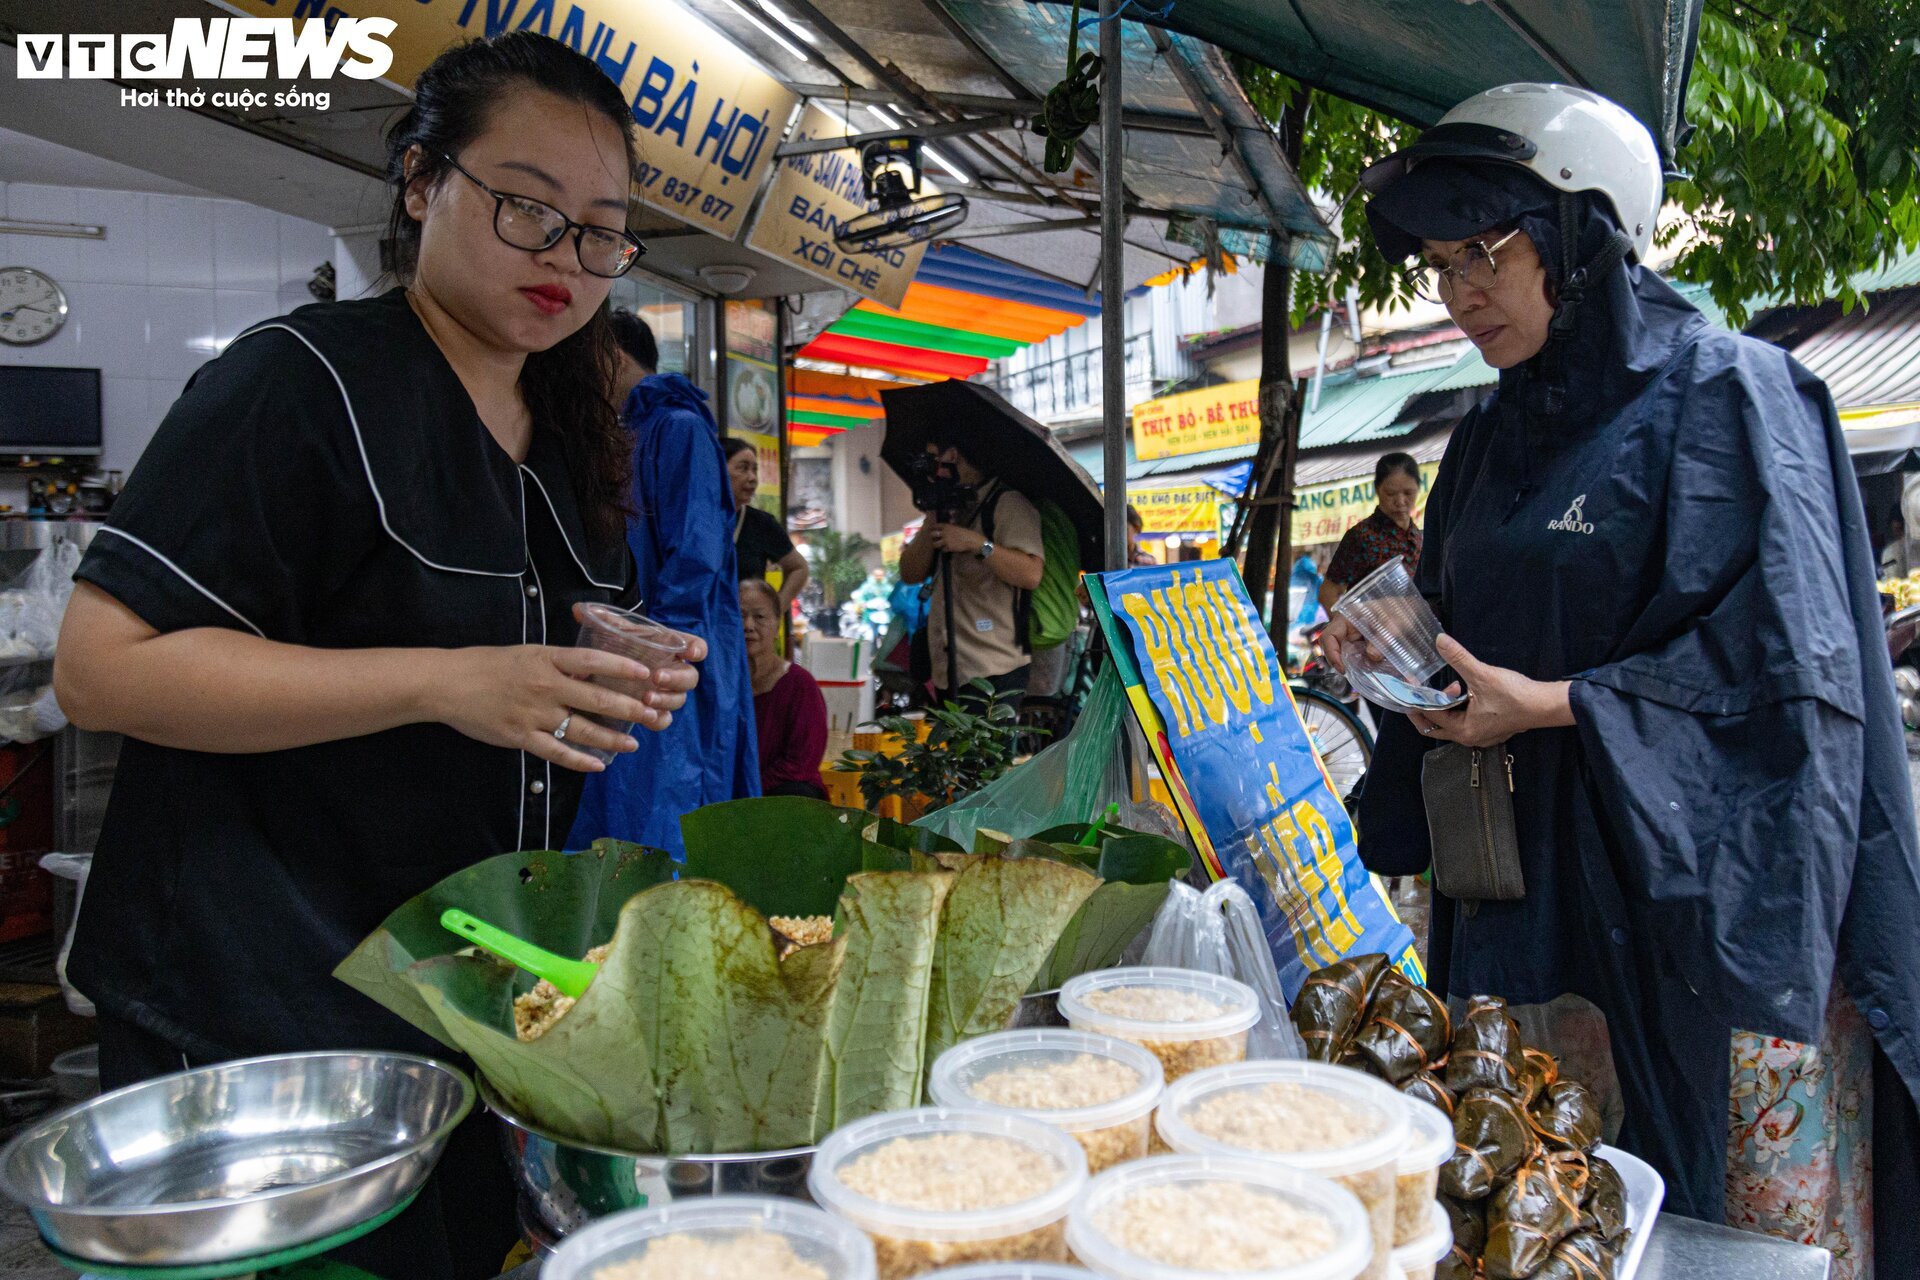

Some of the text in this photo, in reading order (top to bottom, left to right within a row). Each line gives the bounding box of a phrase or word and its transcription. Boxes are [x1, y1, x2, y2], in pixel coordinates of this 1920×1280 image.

[632, 57, 698, 147] BÀ
[662, 177, 702, 206] 837
[702, 195, 735, 221] 877
[793, 235, 835, 270] XÔI
[1142, 416, 1172, 438] THỊT
[1178, 407, 1197, 430] BÒ
[1547, 519, 1595, 535] RANDO
[1121, 568, 1274, 743] RƯỢU
[1245, 762, 1365, 972] NẾP
